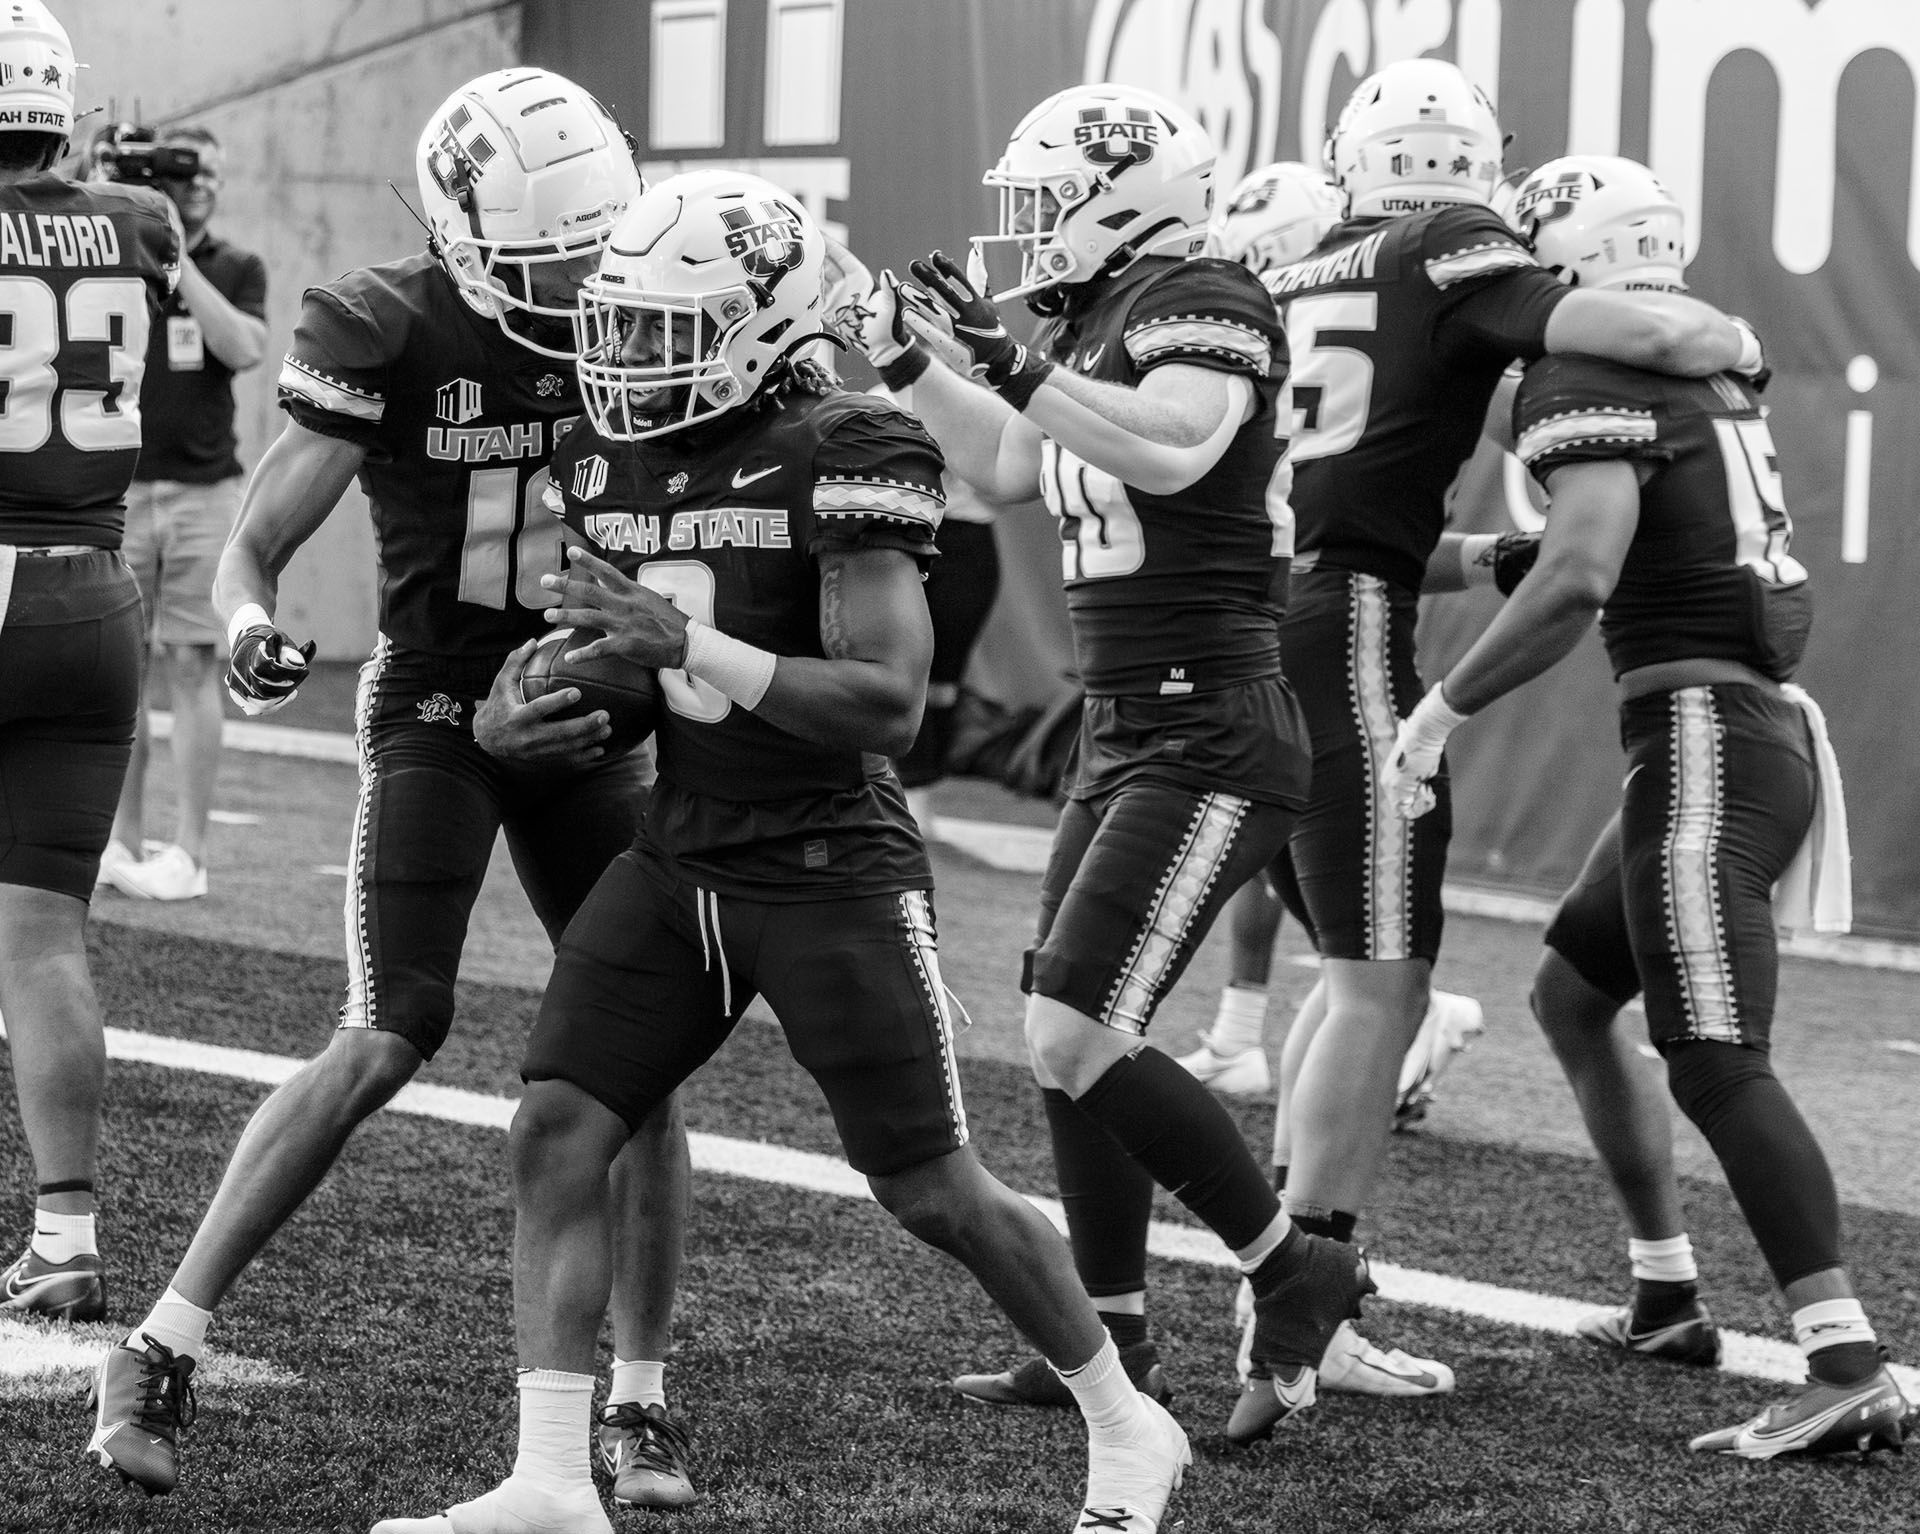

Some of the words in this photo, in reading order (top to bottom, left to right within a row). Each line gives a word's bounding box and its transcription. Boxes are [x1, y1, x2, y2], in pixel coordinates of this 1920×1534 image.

[27, 111, 65, 127] STATE
[1074, 123, 1159, 146] STATE
[1382, 199, 1425, 212] UTAH
[1515, 184, 1582, 215] STATE
[0, 212, 120, 267] ALFORD
[724, 218, 804, 259] STATE
[0, 275, 150, 453] 83
[427, 421, 543, 463] UTAH
[584, 512, 661, 555] UTAH
[667, 507, 792, 551] STATE
